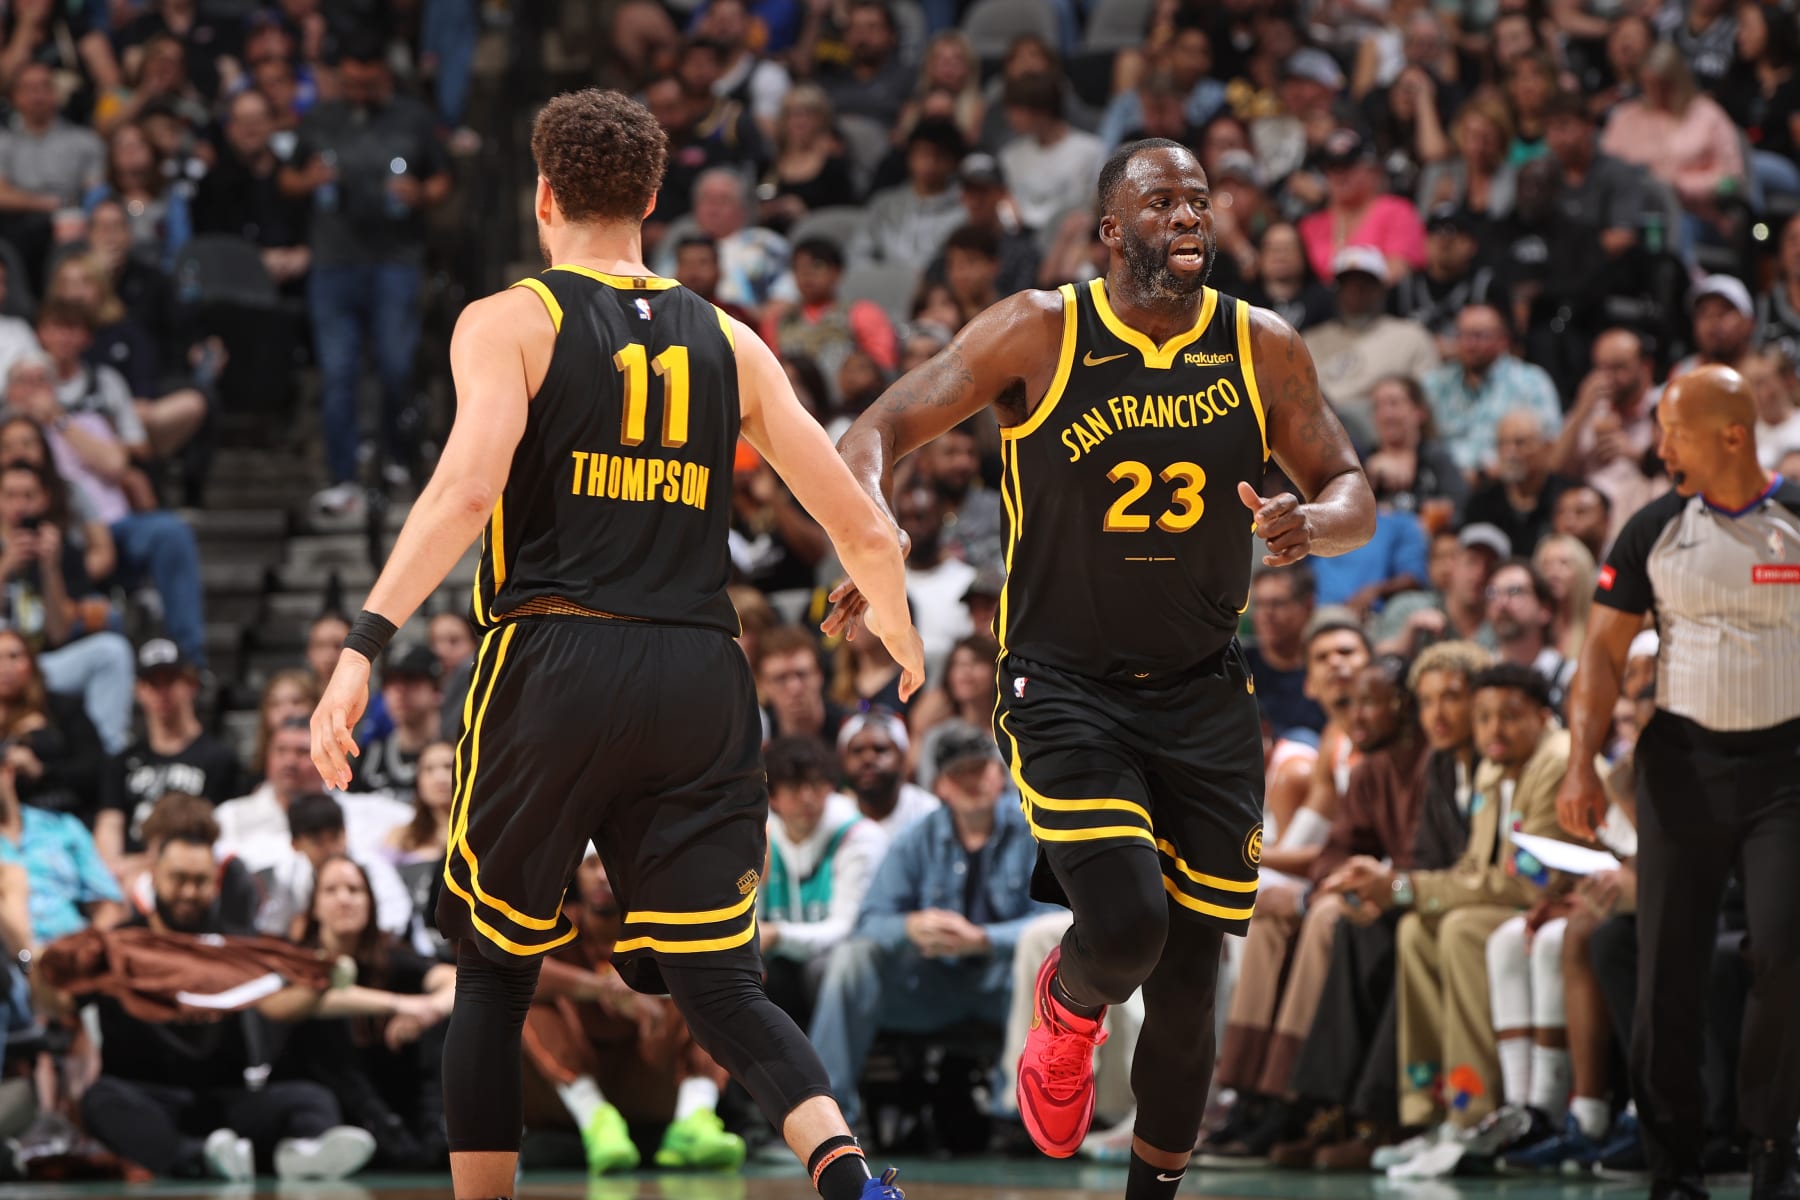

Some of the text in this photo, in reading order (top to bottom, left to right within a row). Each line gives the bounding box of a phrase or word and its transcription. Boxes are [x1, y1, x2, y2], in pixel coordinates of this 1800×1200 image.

[1184, 352, 1234, 364] Rakuten
[613, 342, 690, 449] 11
[1061, 378, 1240, 463] SAN FRANCISCO
[571, 451, 710, 511] THOMPSON
[1103, 460, 1207, 533] 23
